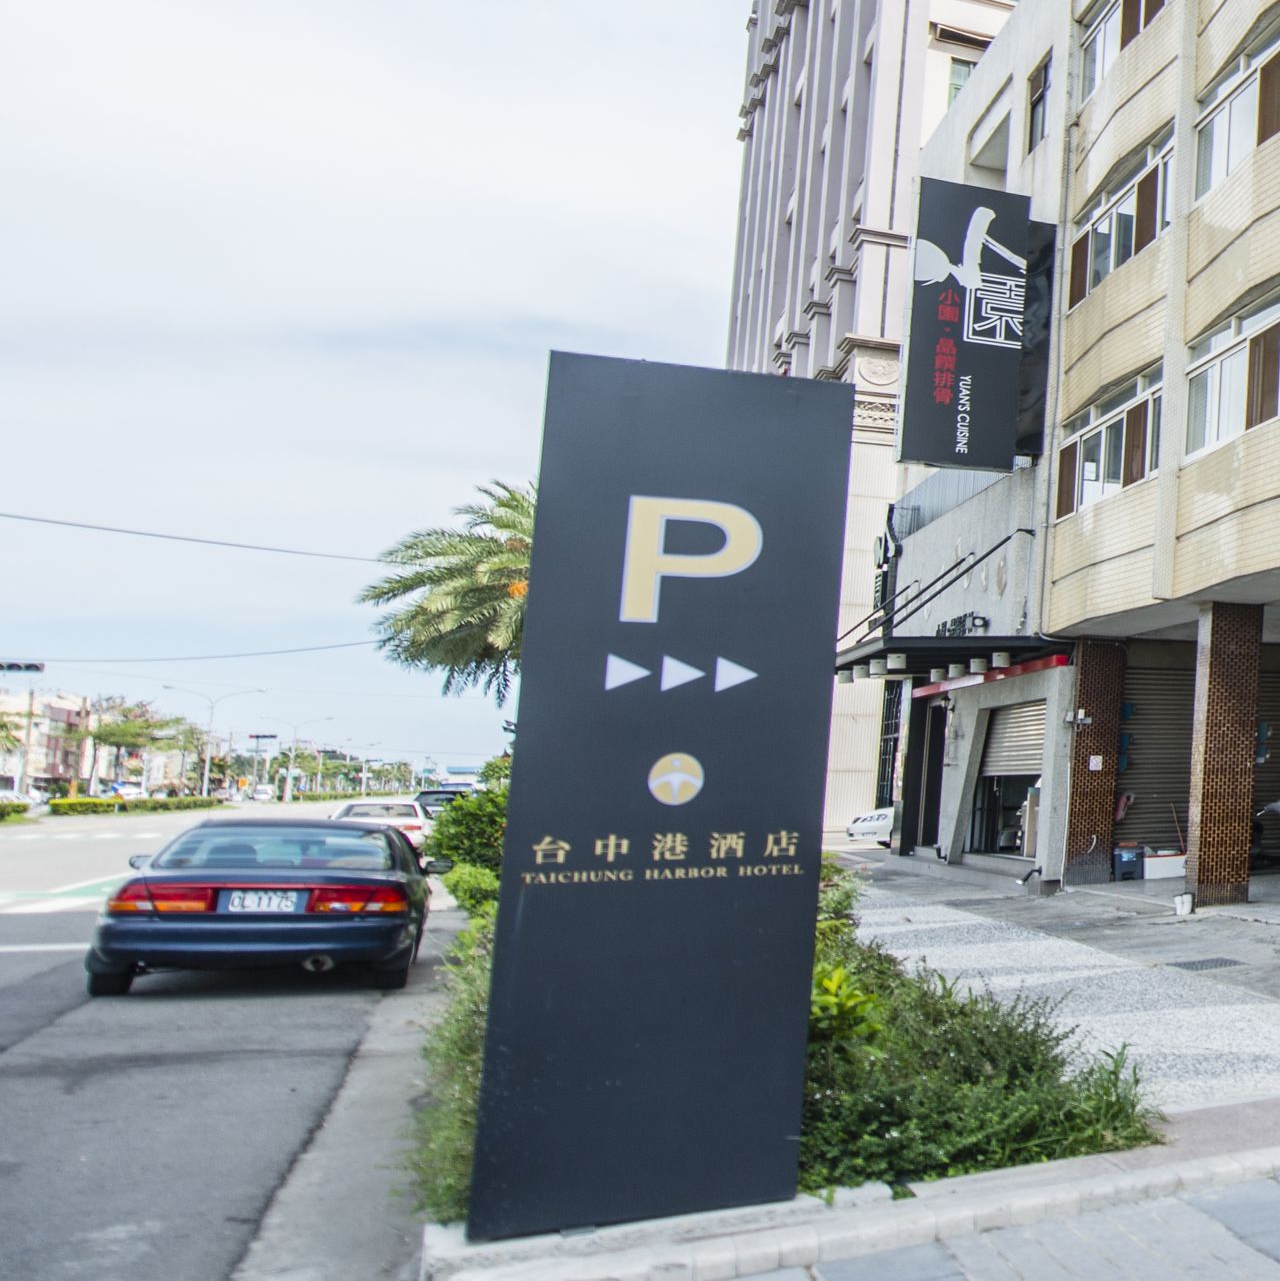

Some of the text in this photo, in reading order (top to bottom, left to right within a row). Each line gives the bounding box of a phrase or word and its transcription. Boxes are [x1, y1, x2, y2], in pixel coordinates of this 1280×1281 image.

[955, 413, 970, 454] CUISINE
[619, 495, 763, 623] P
[532, 831, 799, 864] 台中港酒店
[521, 864, 804, 884] TAICHUNG HARBOR HOTEL
